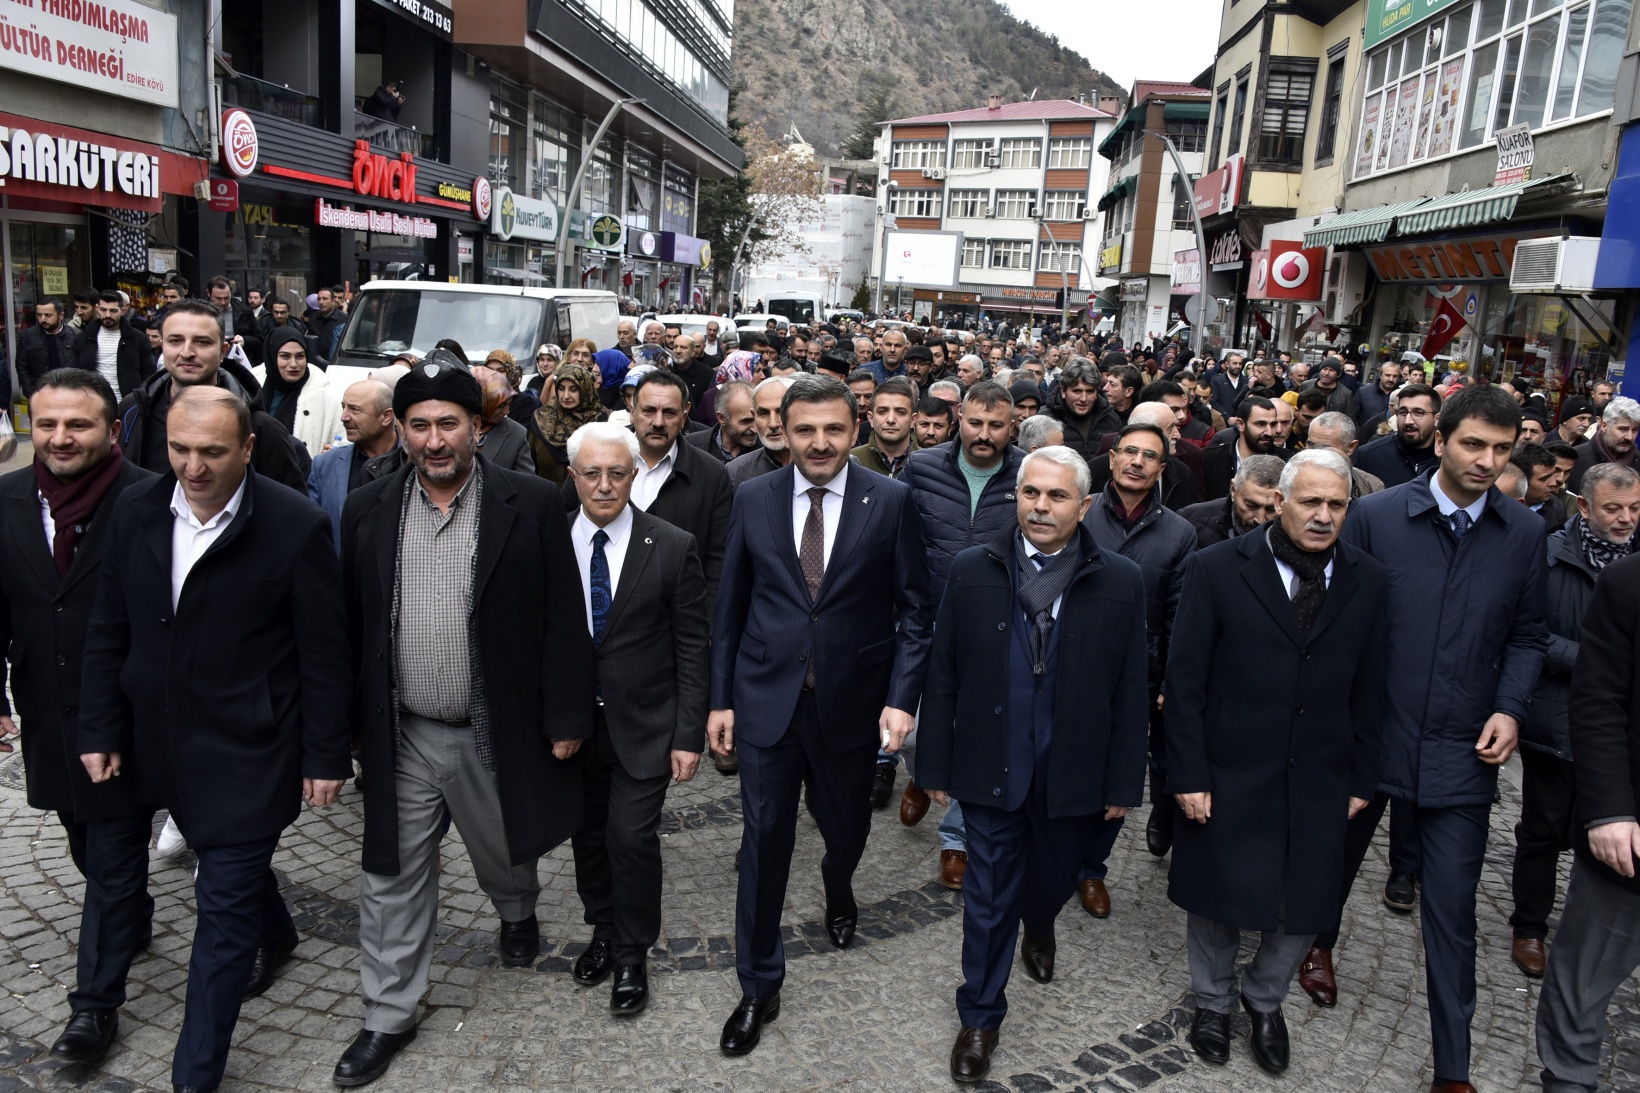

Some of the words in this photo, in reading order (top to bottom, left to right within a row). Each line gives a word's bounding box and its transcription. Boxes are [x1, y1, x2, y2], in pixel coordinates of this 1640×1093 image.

[422, 5, 434, 24] 213
[435, 12, 443, 28] 13
[443, 17, 452, 33] 63
[0, 14, 52, 62] ÜLTÜR
[56, 40, 124, 80] DERNEĞİ
[126, 73, 146, 87] EDİRE
[147, 78, 164, 92] KÖYÜ
[0, 126, 159, 198] ŞARKÜTERİ
[438, 182, 471, 202] GÜMÜŞHANE
[318, 197, 369, 230] İskenderun
[367, 210, 393, 233] Usulü
[392, 213, 415, 236] Soslu
[412, 218, 438, 239] Dürüm
